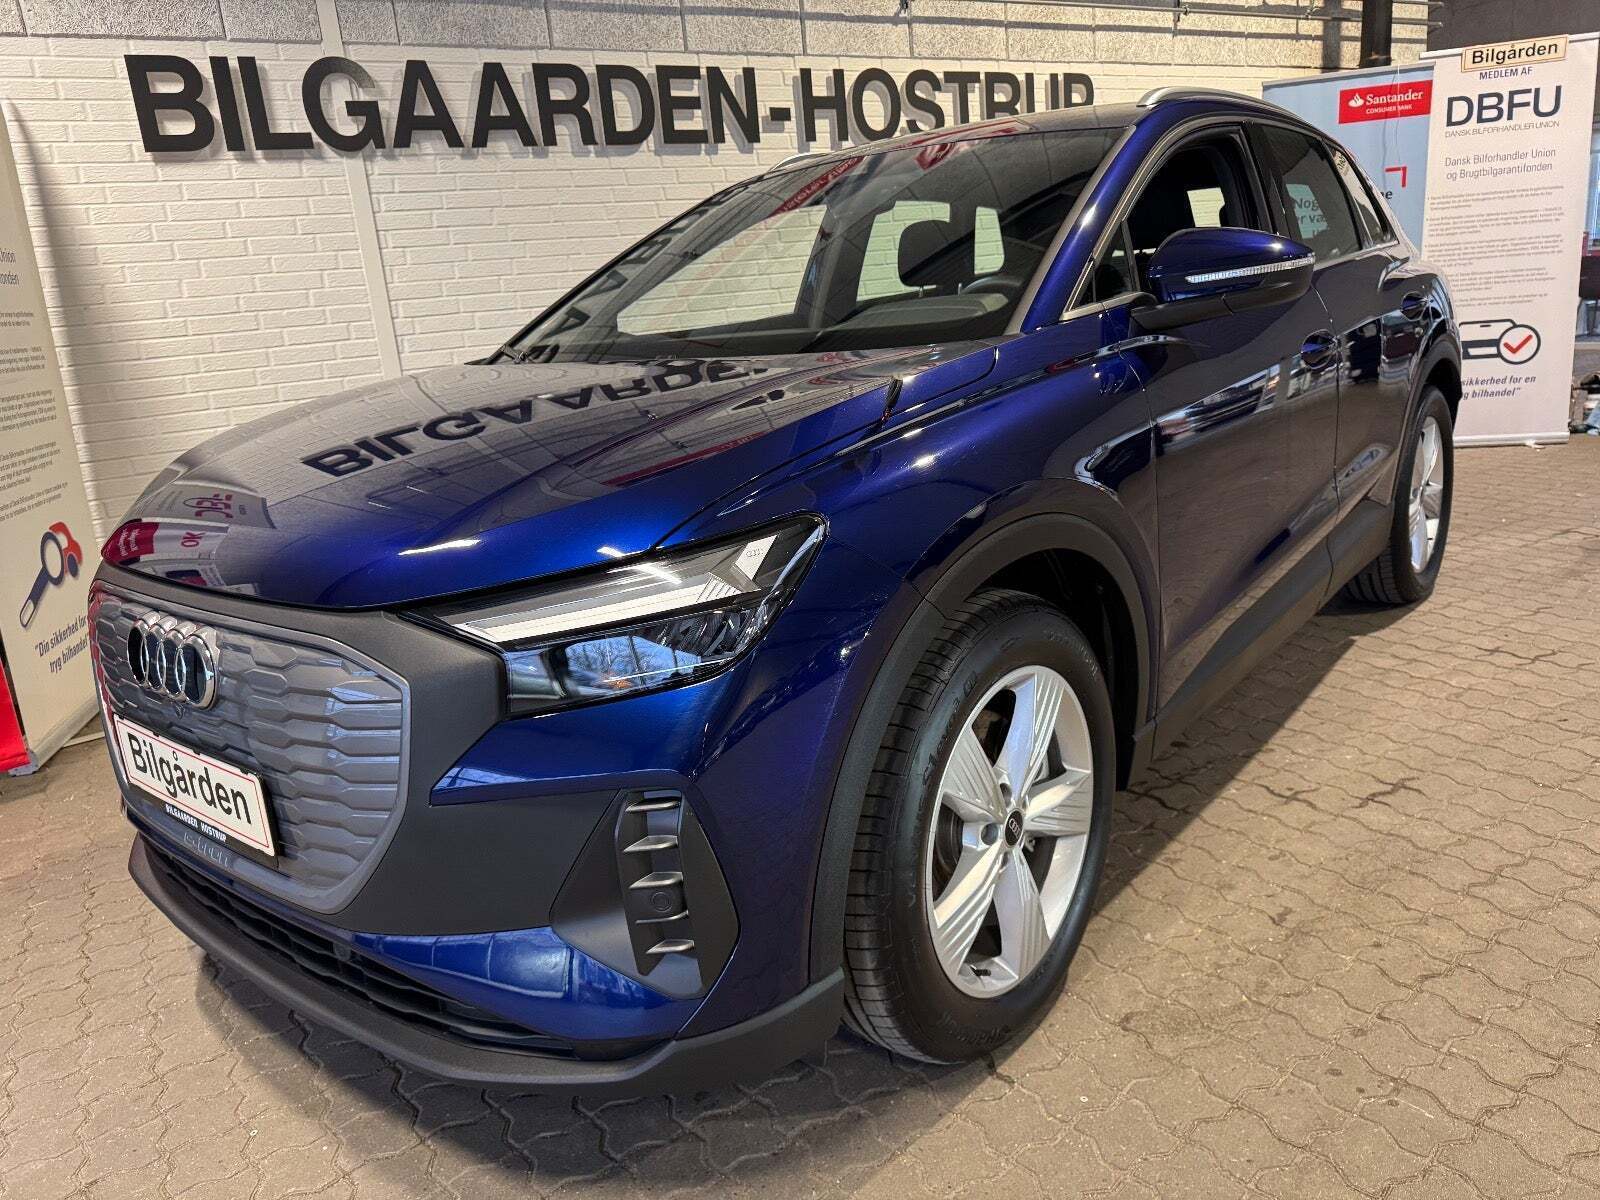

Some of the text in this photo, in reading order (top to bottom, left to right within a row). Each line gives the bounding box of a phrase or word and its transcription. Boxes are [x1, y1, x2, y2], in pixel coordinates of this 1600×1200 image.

[1472, 42, 1558, 65] Bilgården
[1479, 67, 1534, 81] MEDLEM AF
[1365, 89, 1424, 106] Santander
[1446, 85, 1563, 128] DBFU
[1445, 120, 1560, 139] DANSK BILFORHANDLER UNION
[1445, 148, 1556, 167] Dansk Bilforhandler Union
[1446, 162, 1553, 182] og Brugtbilgarantifonden
[1509, 375, 1523, 384] for
[1524, 375, 1536, 384] en
[49, 616, 79, 650] sikkerhed
[49, 657, 63, 674] tryg
[127, 732, 252, 826] Bilgården
